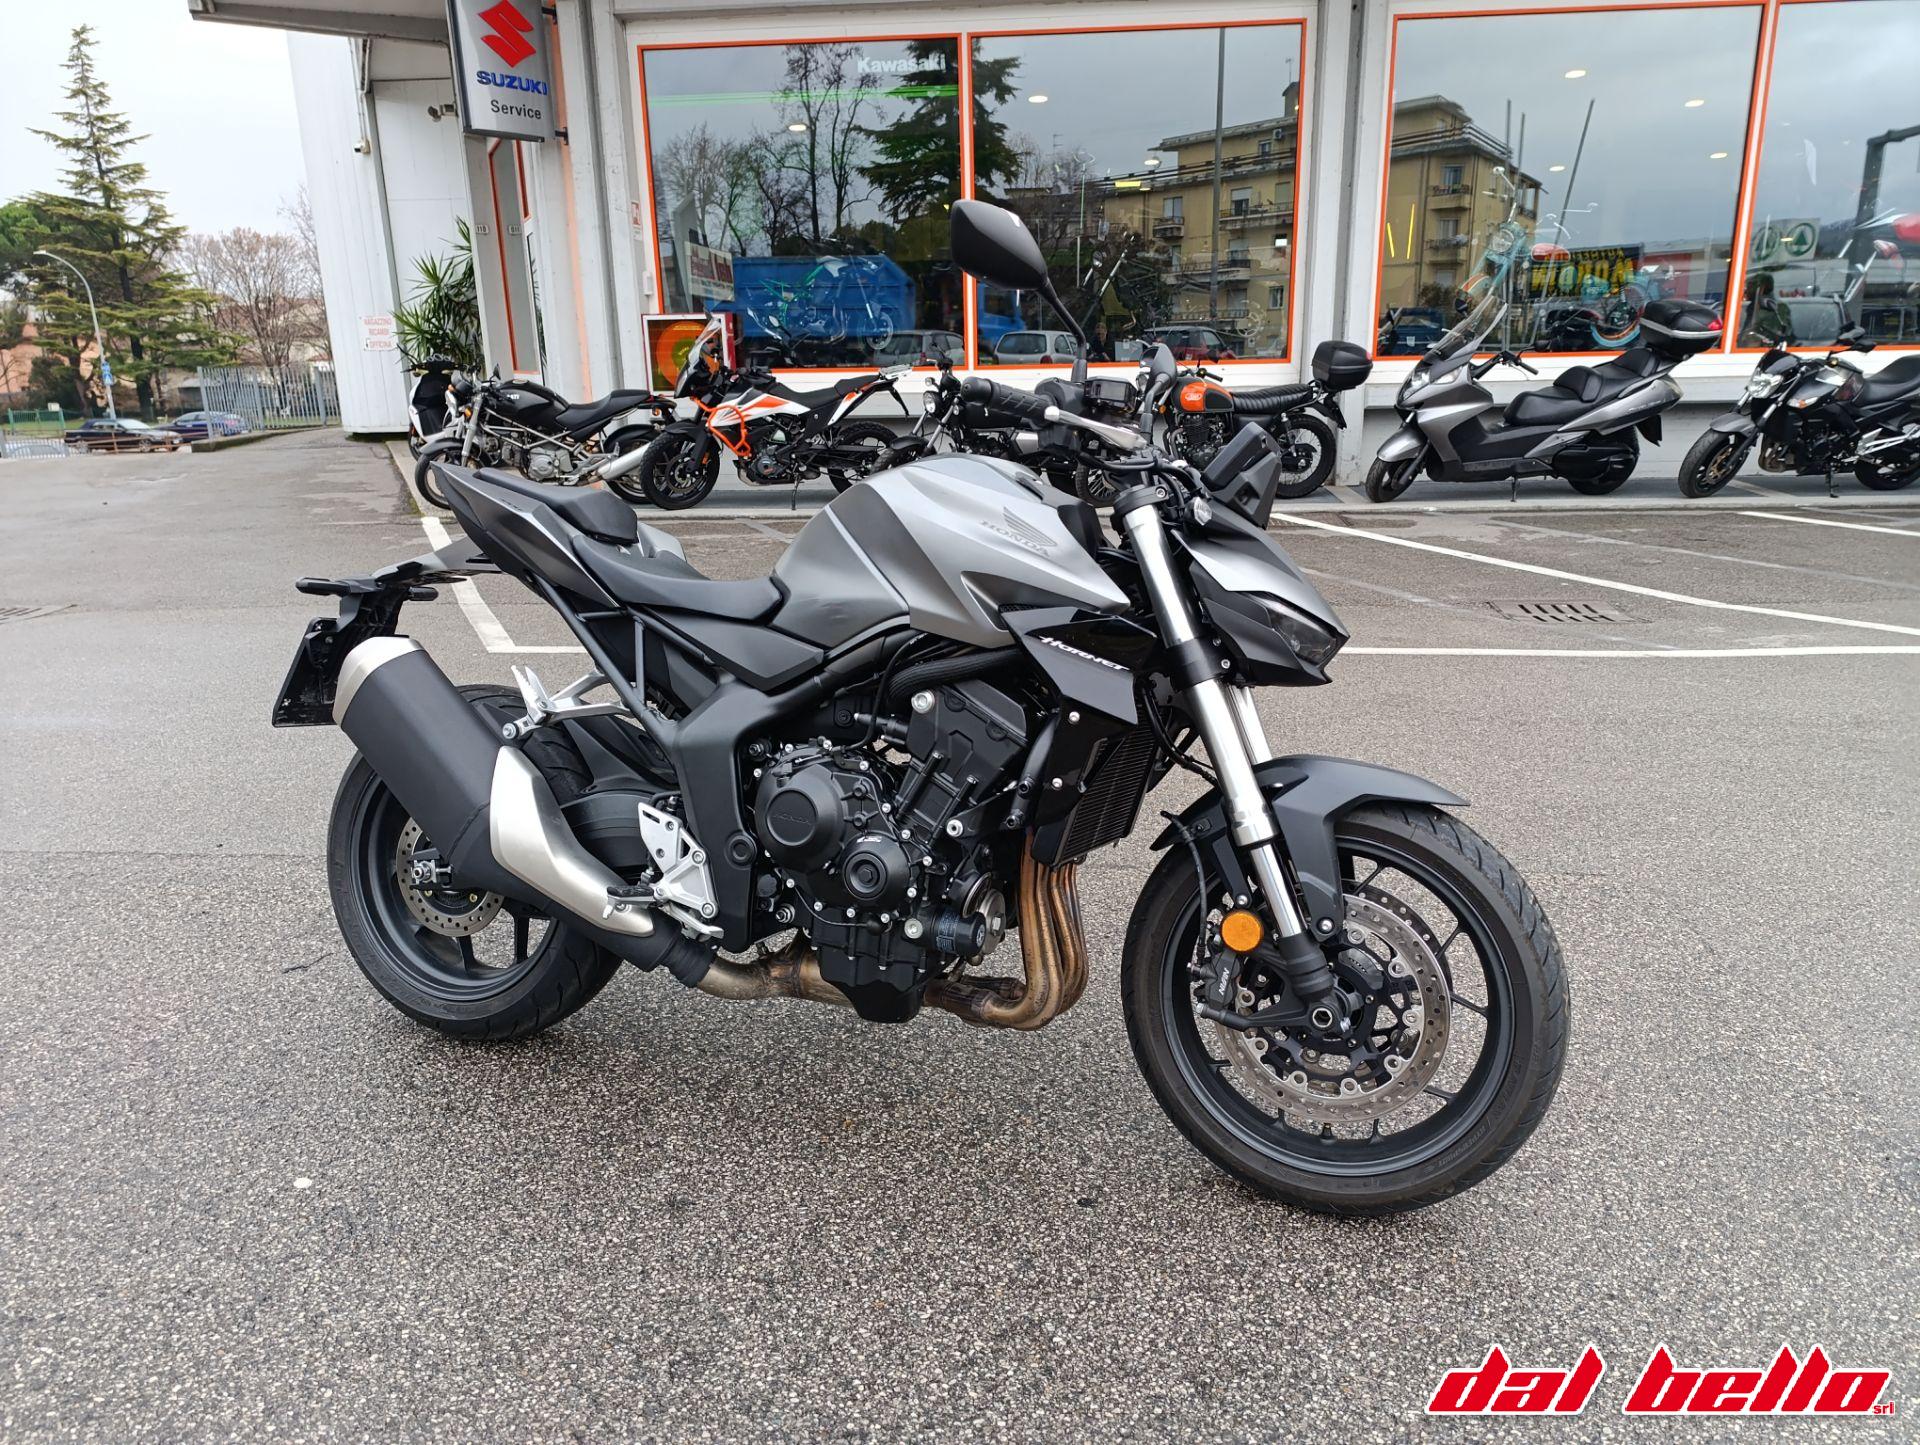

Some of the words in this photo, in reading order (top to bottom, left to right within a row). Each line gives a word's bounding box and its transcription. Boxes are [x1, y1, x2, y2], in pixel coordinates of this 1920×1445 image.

[857, 53, 946, 73] Kawasaki
[476, 70, 548, 95] SUZUKI
[490, 99, 542, 120] Service
[979, 519, 1051, 557] HONDA
